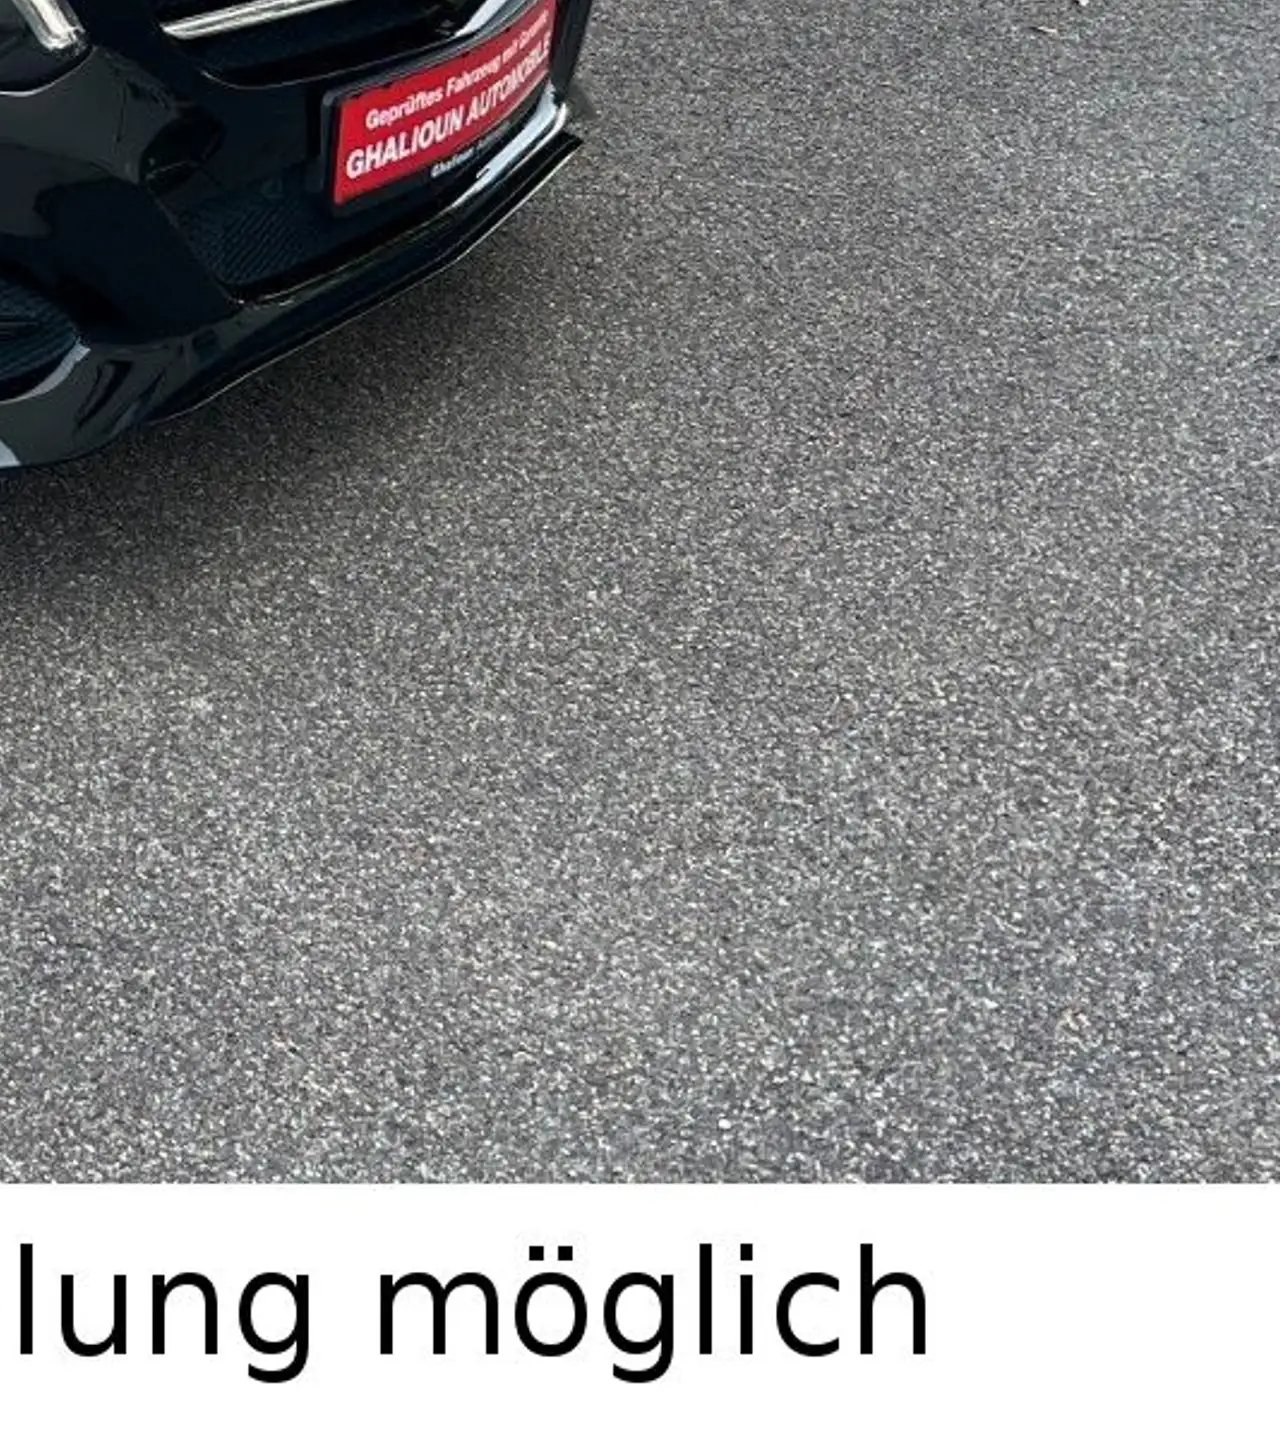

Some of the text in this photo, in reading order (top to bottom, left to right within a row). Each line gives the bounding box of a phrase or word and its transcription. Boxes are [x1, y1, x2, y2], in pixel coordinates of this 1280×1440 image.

[345, 30, 552, 180] GHALIOUN AUTOMOBILE
[365, 86, 444, 130] Geprüftes
[445, 52, 501, 97] Fahrzeug
